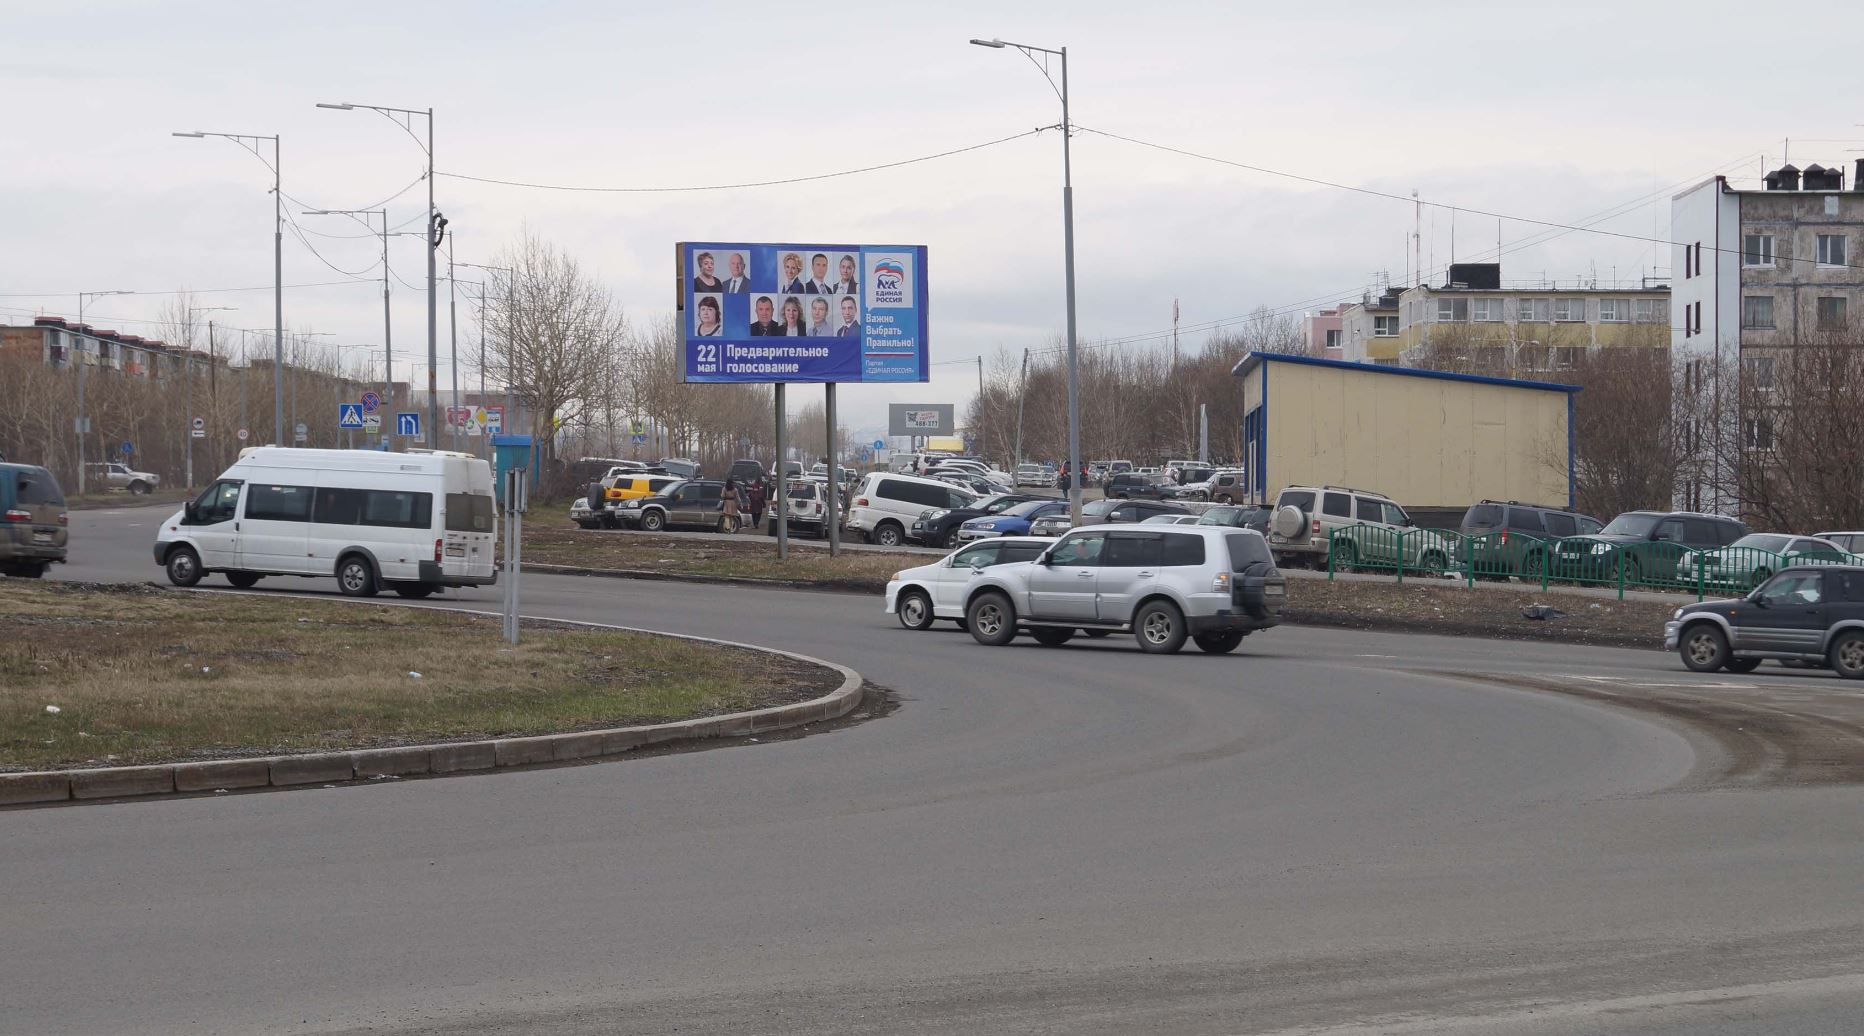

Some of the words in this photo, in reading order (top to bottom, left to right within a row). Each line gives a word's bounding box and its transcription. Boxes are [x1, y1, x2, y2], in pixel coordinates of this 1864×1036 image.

[865, 313, 894, 323] Важно
[865, 325, 902, 337] Выбрать
[866, 336, 915, 349] Правильно!
[697, 344, 716, 362] 22
[726, 344, 829, 360] Предварительное
[697, 363, 716, 373] мая
[726, 363, 799, 373] голосование
